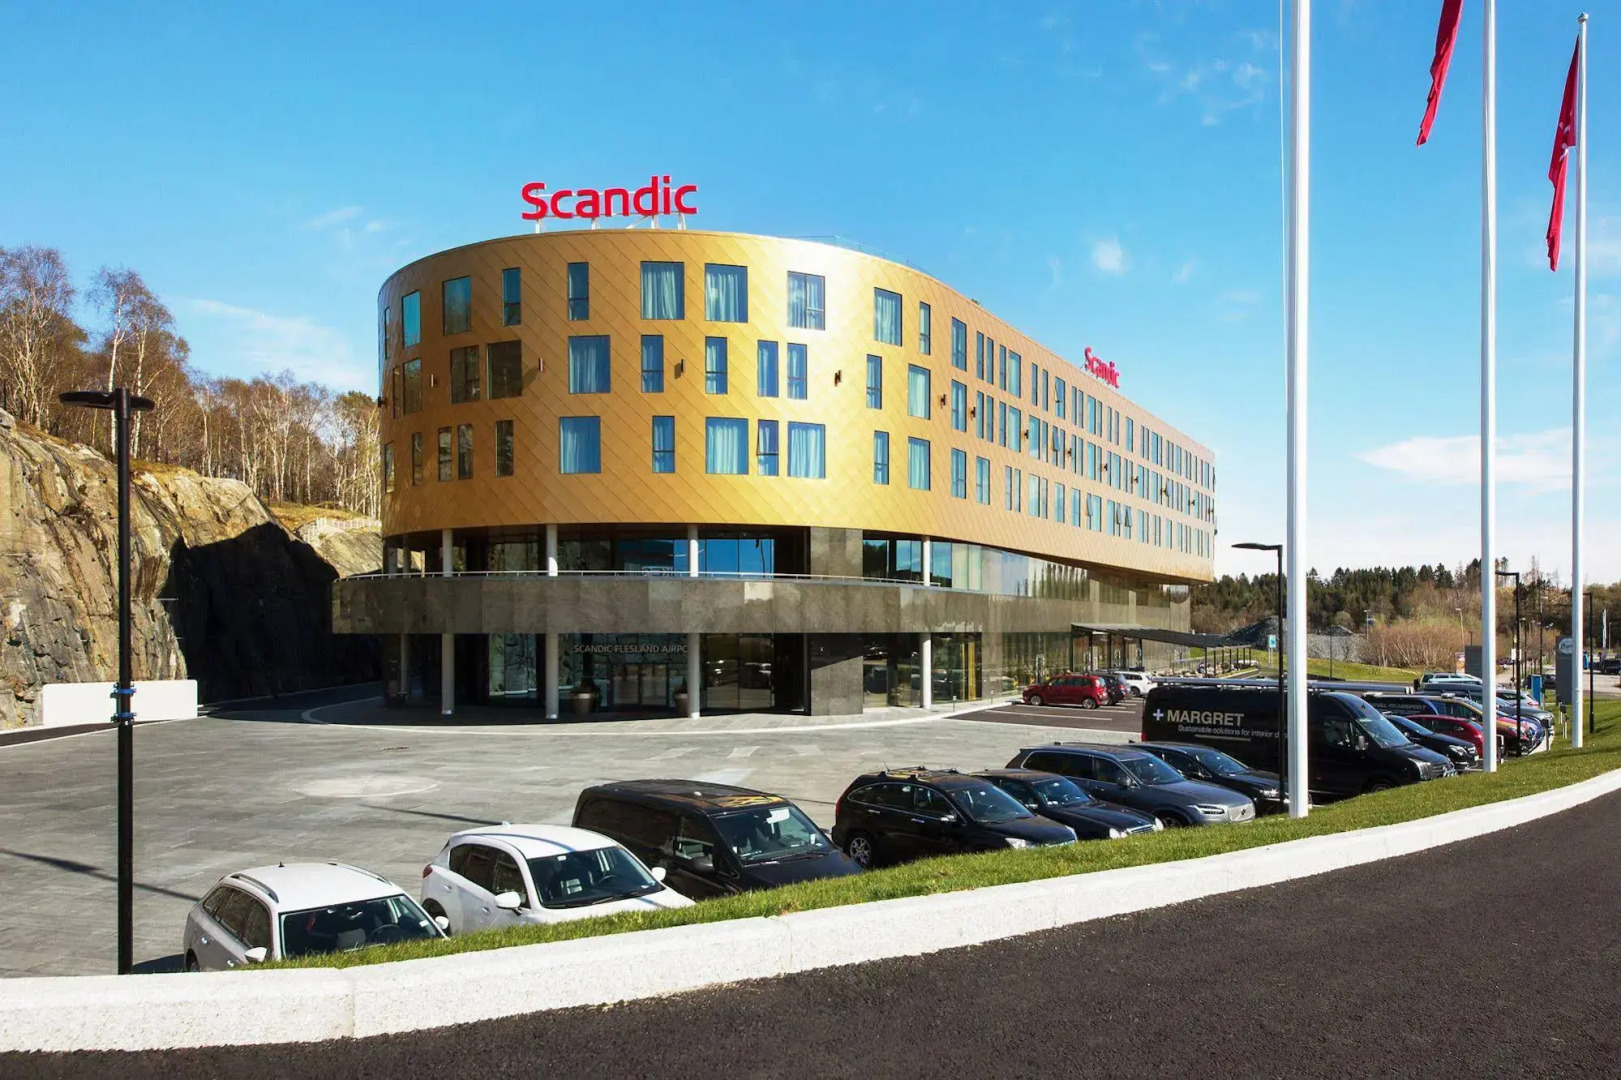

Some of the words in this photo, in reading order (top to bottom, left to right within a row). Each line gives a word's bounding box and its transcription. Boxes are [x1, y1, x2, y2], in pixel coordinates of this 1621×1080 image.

[521, 175, 698, 220] Scandic
[573, 644, 613, 653] SCANDIC
[614, 644, 660, 653] FLESLAND
[661, 644, 689, 653] AIRPO
[1166, 709, 1245, 727] MARGRET
[1178, 724, 1213, 734] Sustainable
[1212, 726, 1240, 736] solutions
[1241, 728, 1251, 737] for
